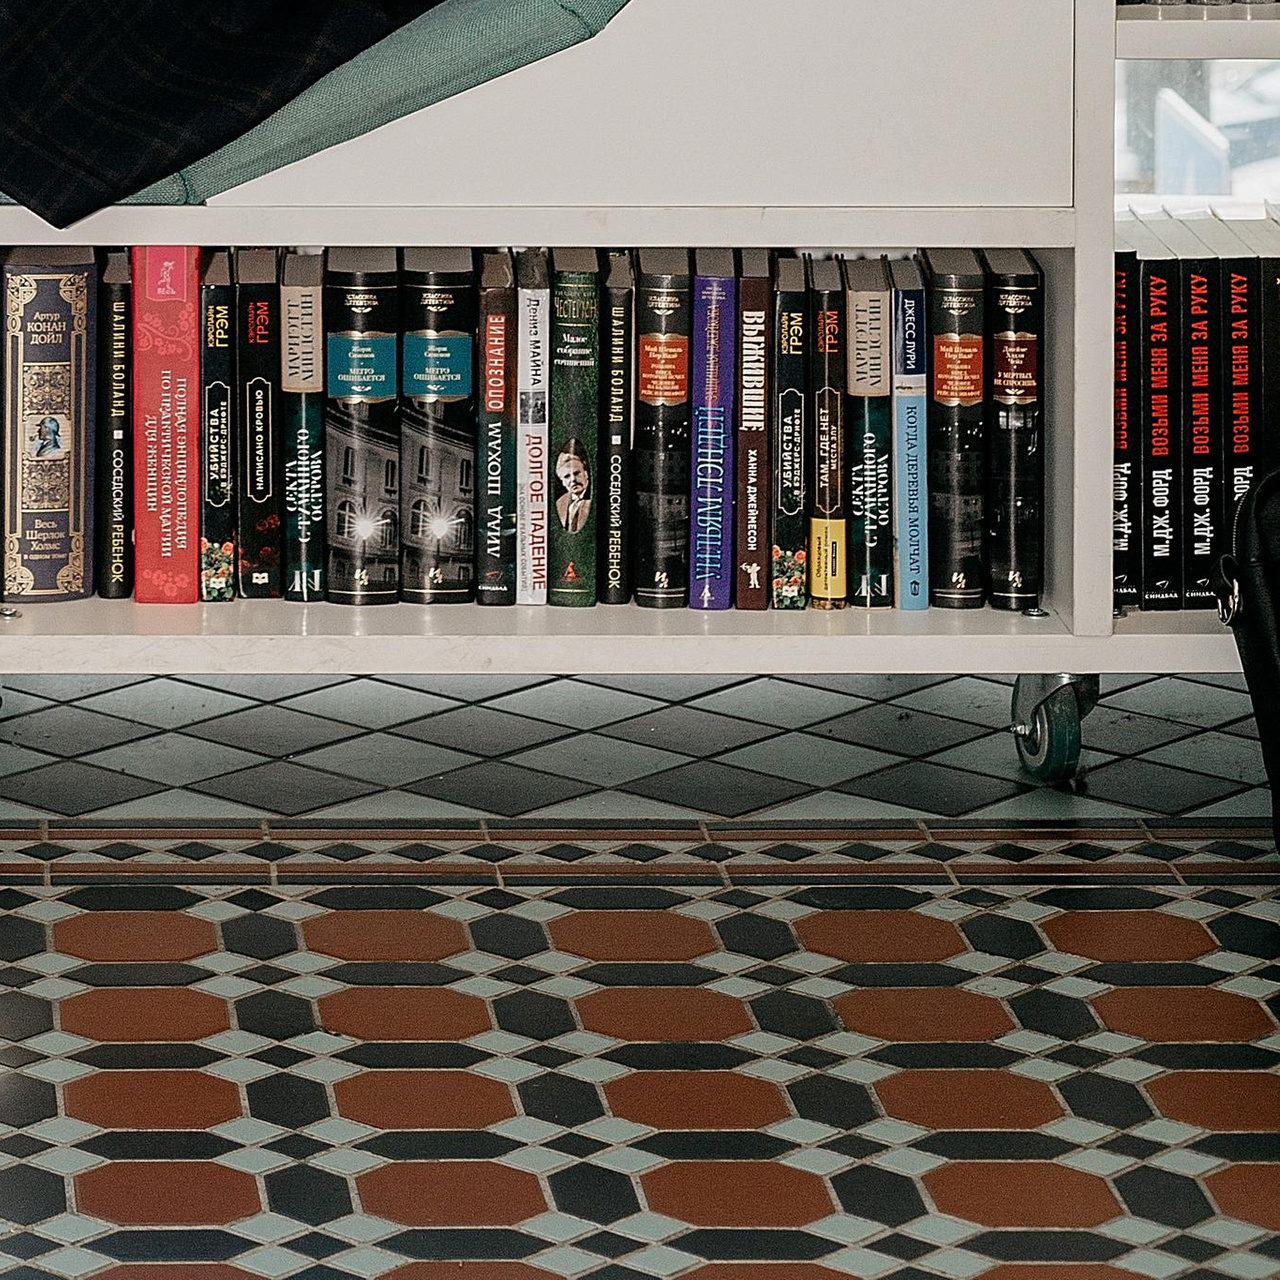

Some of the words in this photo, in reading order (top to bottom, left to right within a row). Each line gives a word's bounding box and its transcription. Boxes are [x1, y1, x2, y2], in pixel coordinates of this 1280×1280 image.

[1150, 275, 1167, 316] РУКУ
[1191, 274, 1208, 315] РУКУ
[1231, 273, 1248, 313] РУКУ
[26, 322, 66, 332] КОНАН
[30, 332, 63, 345] ДОЙЛ
[33, 312, 60, 323] Артур
[112, 302, 125, 358] ШАЛИНИ
[206, 305, 215, 347] КЭРОЛАЙН
[215, 305, 229, 348] ГРЭМ
[256, 302, 269, 344] ГРЭМ
[287, 300, 300, 378] МАРИЭТТ
[527, 298, 541, 336] Дениз
[611, 307, 624, 366] ШАЛИНИ
[781, 312, 789, 354] КЭРОЛАЙН
[789, 312, 803, 354] ГРЭМ
[826, 310, 839, 352] ГРЭМ
[903, 299, 916, 339] ДЖЕСС
[1151, 322, 1167, 342] ЗА
[1191, 321, 1208, 340] ЗА
[1232, 320, 1248, 339] ЗА
[487, 315, 505, 410] ОПОЗНАНИЕ
[529, 339, 543, 386] МАЙНА
[855, 303, 868, 383] МАРИЭТТ
[904, 340, 916, 369] ЛУРИ
[1191, 346, 1208, 386] МЕНЯ
[1232, 345, 1249, 385] МЕНЯ
[111, 364, 125, 418] БОЛАНД
[160, 369, 172, 390] ПО
[739, 310, 765, 431] ВЫЖИВШИЕ
[1151, 348, 1168, 388] МЕНЯ
[175, 378, 187, 433] ПОЛНАЯ
[255, 390, 264, 431] КРОВЬЮ
[610, 370, 624, 423] БОЛАНД
[819, 407, 829, 430] НЕТ
[145, 415, 158, 441] ДЛЯ
[208, 408, 220, 480] УБИЙСТВА
[820, 433, 830, 457] ГДЕ
[830, 424, 838, 441] ЗЛУ
[904, 406, 918, 451] КОГДА
[1152, 395, 1169, 455] ВОЗЬМИ
[1192, 393, 1209, 454] ВОЗЬМИ
[1233, 392, 1249, 453] ВОЗЬМИ
[159, 393, 173, 504] ПРАКТИЧЕСКОЙ
[255, 434, 264, 490] НАПИСАНО
[487, 422, 502, 495] ШОХАМ
[526, 434, 543, 503] ДОЛГОЕ
[696, 406, 729, 491] ЛЭНДЕЙ
[747, 449, 758, 484] ХАННА
[781, 415, 793, 487] УБИЙСТВА
[830, 443, 838, 470] МЕСТА
[112, 449, 125, 522] СОСЕДСКИЙ
[145, 444, 158, 511] ЖЕНЩИН
[175, 435, 187, 549] ЭНЦИКЛОПЕДИЯ
[285, 460, 298, 512] СЕКТА
[296, 429, 311, 529] ТУМАННОГО
[310, 450, 323, 521] ОСТРОВА
[610, 455, 622, 527] СОСЕДСКИЙ
[820, 459, 830, 488] ТАМ,
[852, 464, 864, 515] СЕКТА
[862, 432, 877, 534] ТУМАННОГО
[877, 454, 889, 525] ОСТРОВА
[905, 453, 919, 513] ДЕРЕВЬЯ
[1153, 469, 1172, 507] ФОРД
[1193, 467, 1213, 505] ФОРД
[1234, 466, 1253, 501] ОРД
[26, 530, 66, 541] Шерлок
[34, 520, 58, 530] Весь
[160, 507, 172, 557] МАГИИ
[298, 532, 310, 543] С
[487, 506, 503, 558] ЛИАД
[696, 496, 721, 579] УИЛЬЯМ
[746, 485, 759, 550] ДЖЕЙМЕСОН
[30, 541, 61, 552] Холмс
[111, 524, 124, 582] РЕБЕНОК
[529, 510, 547, 590] ПАДЕНИЕ
[608, 529, 622, 588] РЕБЕНОК
[864, 535, 877, 547] С
[907, 520, 920, 573] МОЛЧАТ
